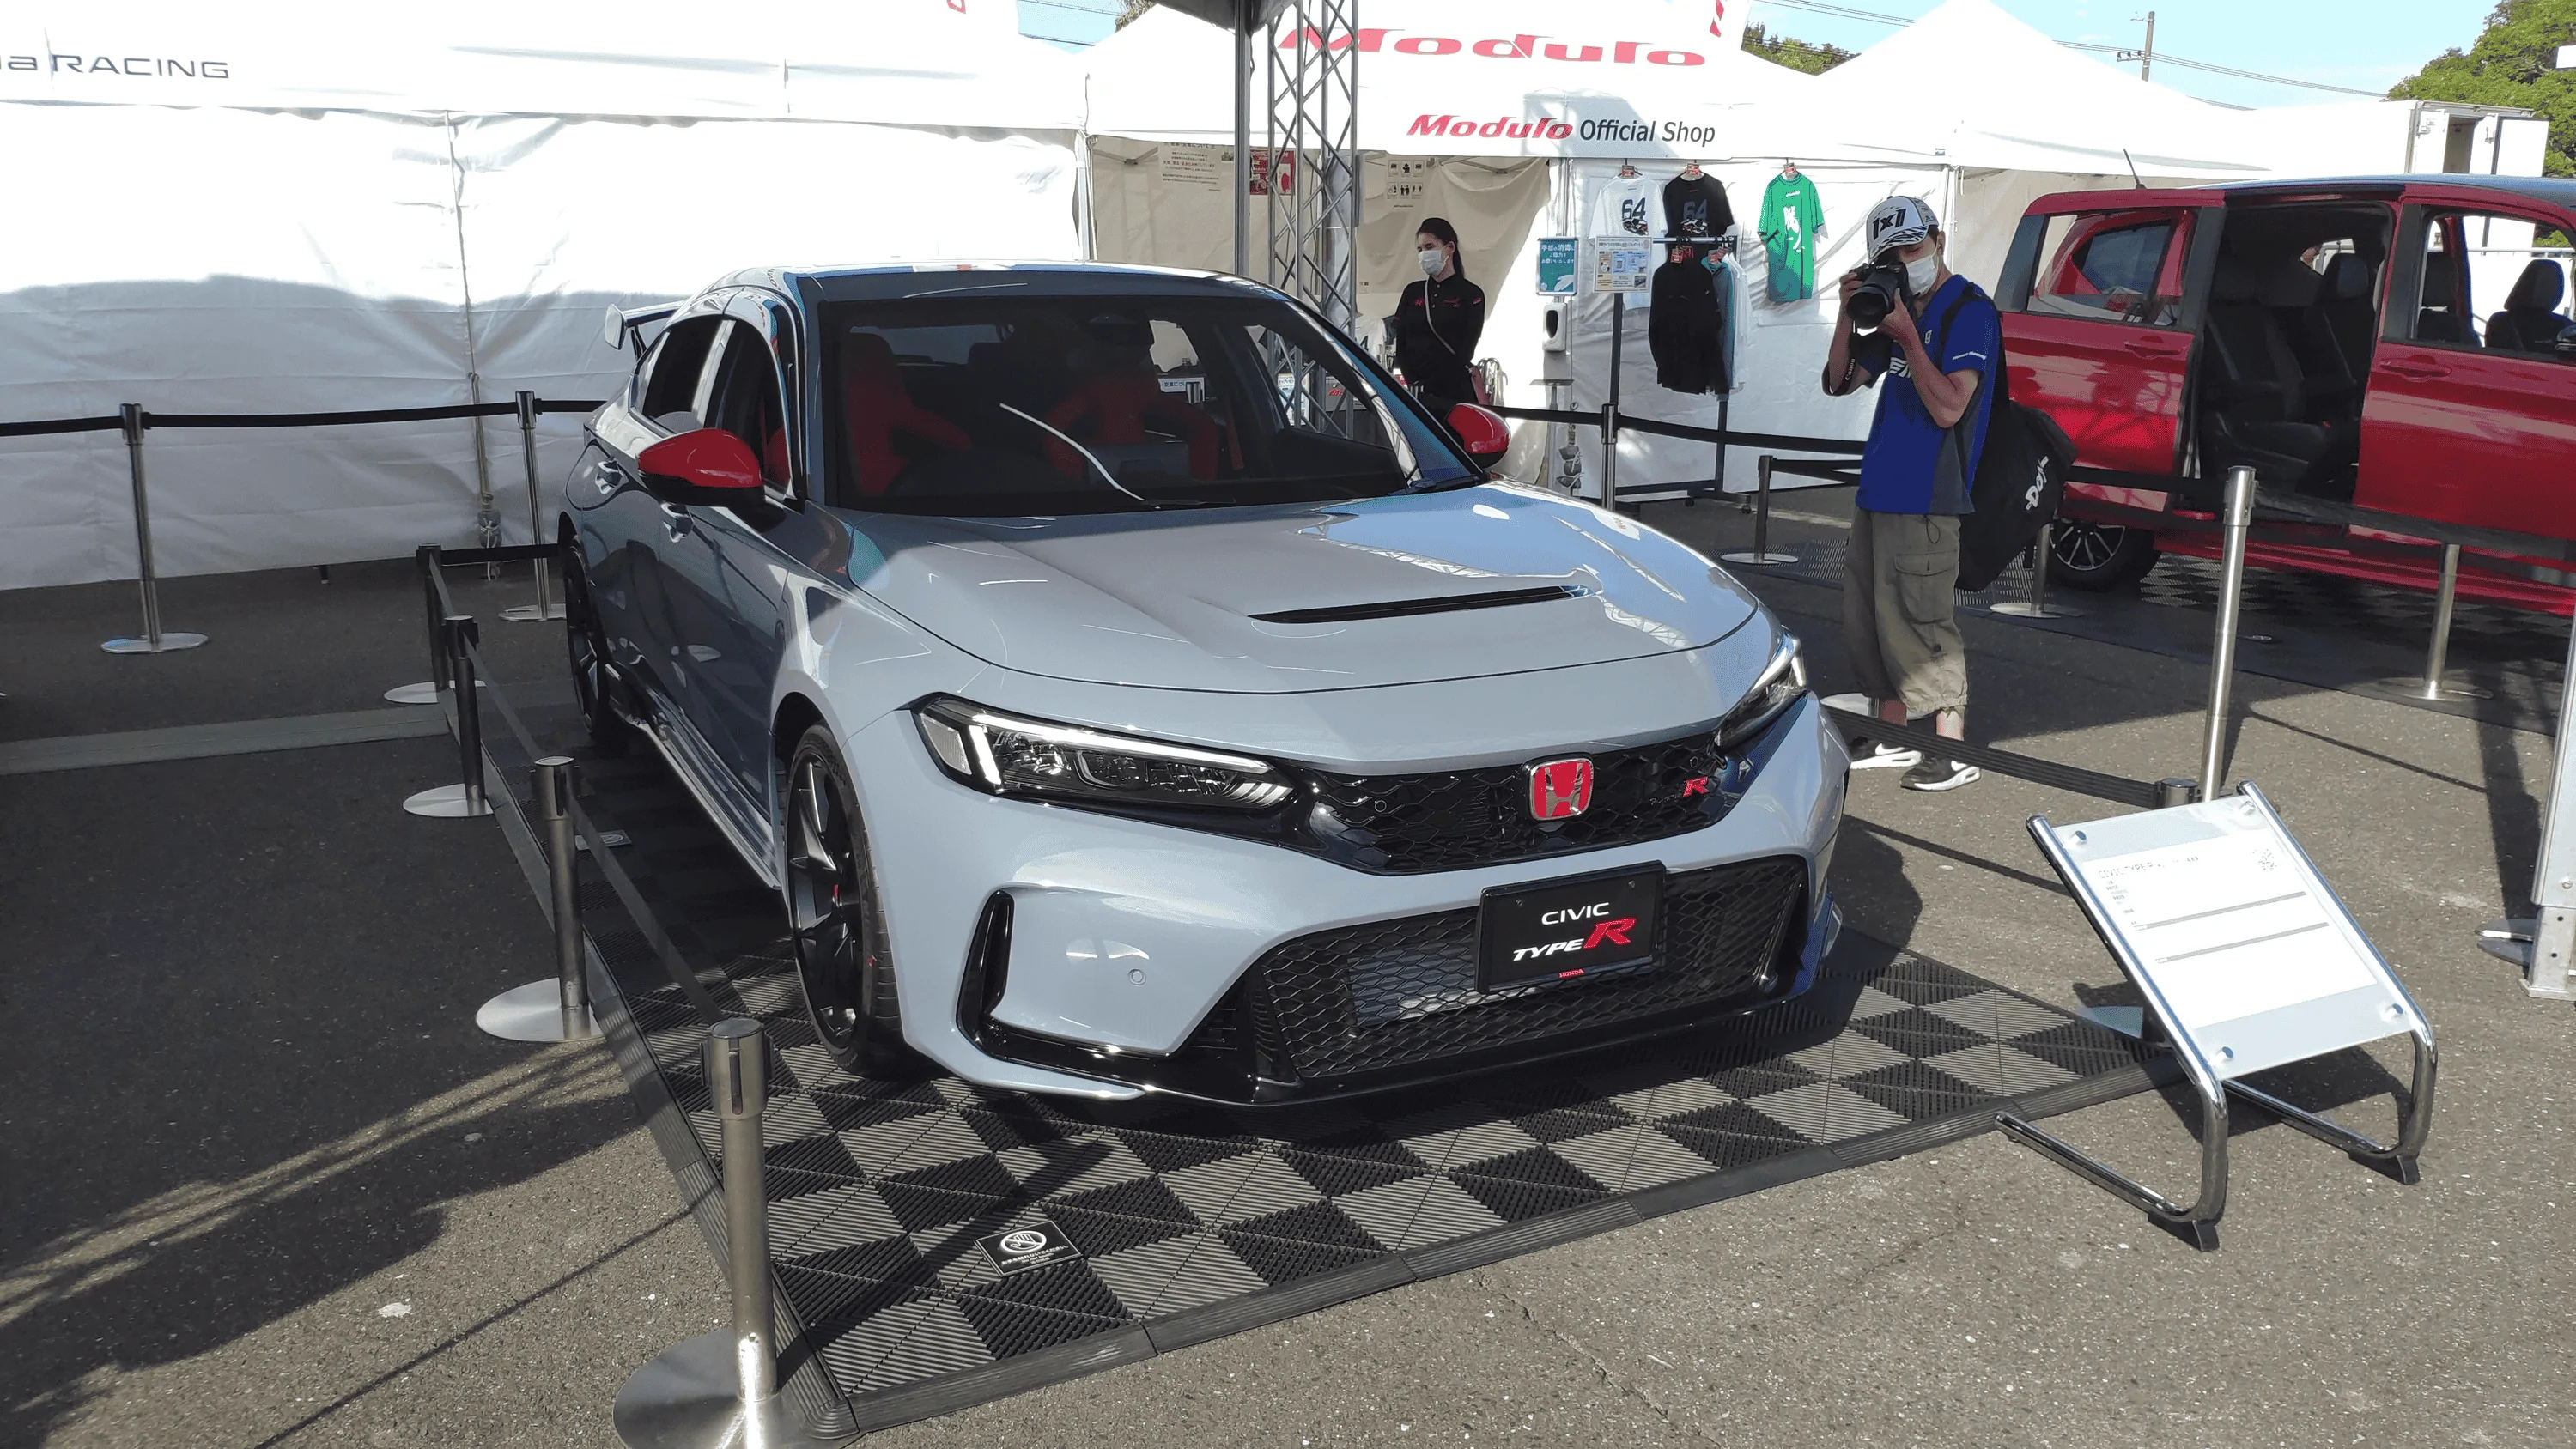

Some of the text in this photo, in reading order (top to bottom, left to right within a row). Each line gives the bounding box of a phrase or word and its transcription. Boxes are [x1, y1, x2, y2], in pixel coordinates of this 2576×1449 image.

[1279, 27, 1705, 66] Modulo
[51, 53, 230, 80] RACING
[1406, 113, 1716, 147] Modulo Official Shop
[1621, 197, 1647, 221] 64
[1683, 198, 1708, 221] 64
[1844, 358, 1856, 381] Canon
[1540, 902, 1610, 925] CIVIC
[1558, 968, 1585, 979] HONDA
